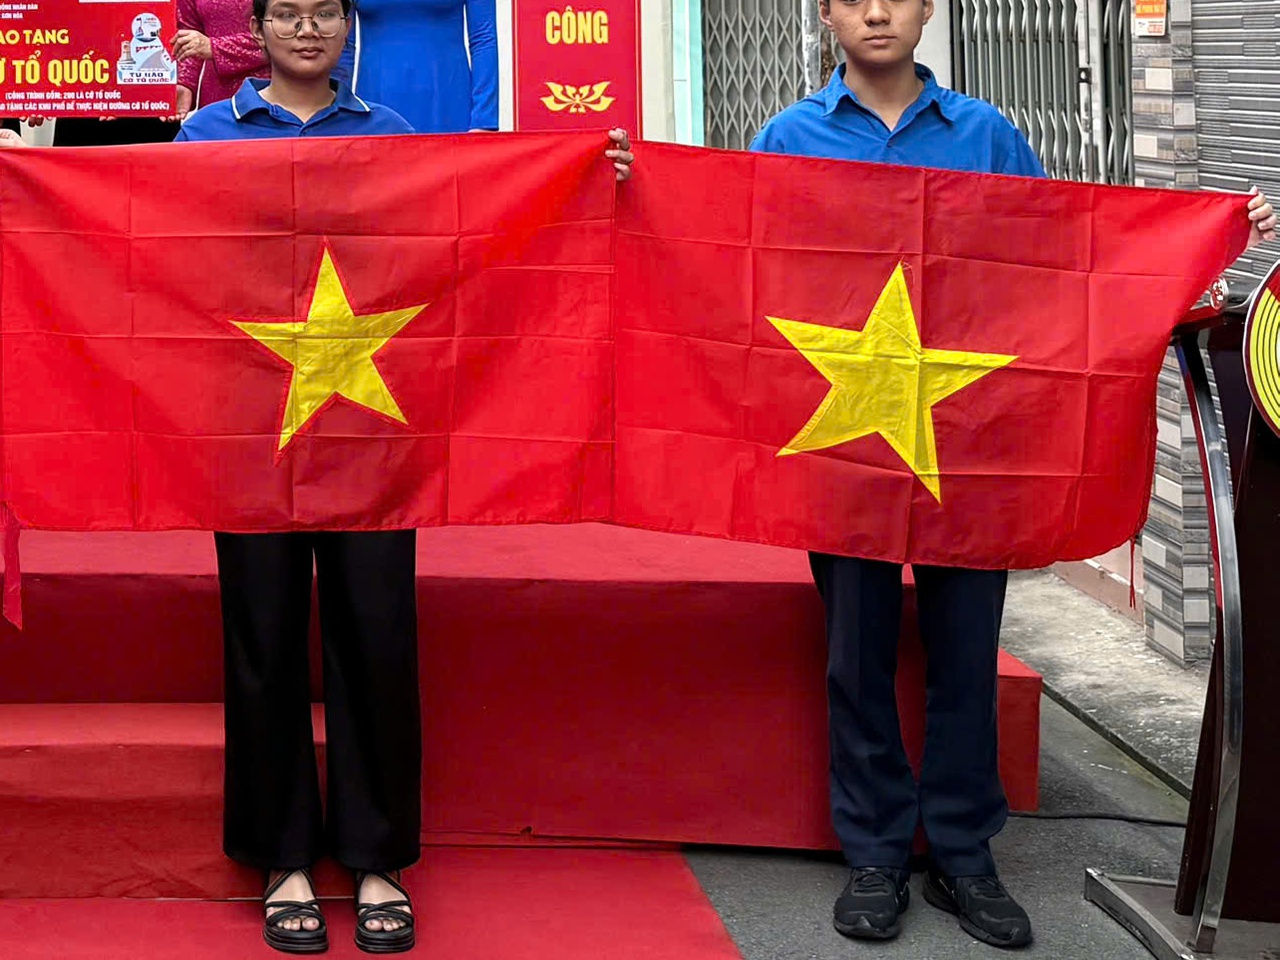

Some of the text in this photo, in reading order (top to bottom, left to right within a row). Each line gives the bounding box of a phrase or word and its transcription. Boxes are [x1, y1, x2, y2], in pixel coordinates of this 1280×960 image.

[23, 28, 69, 46] TẶNG
[545, 6, 609, 44] CÔNG
[12, 49, 42, 85] TỔ
[48, 50, 110, 86] QUỐC
